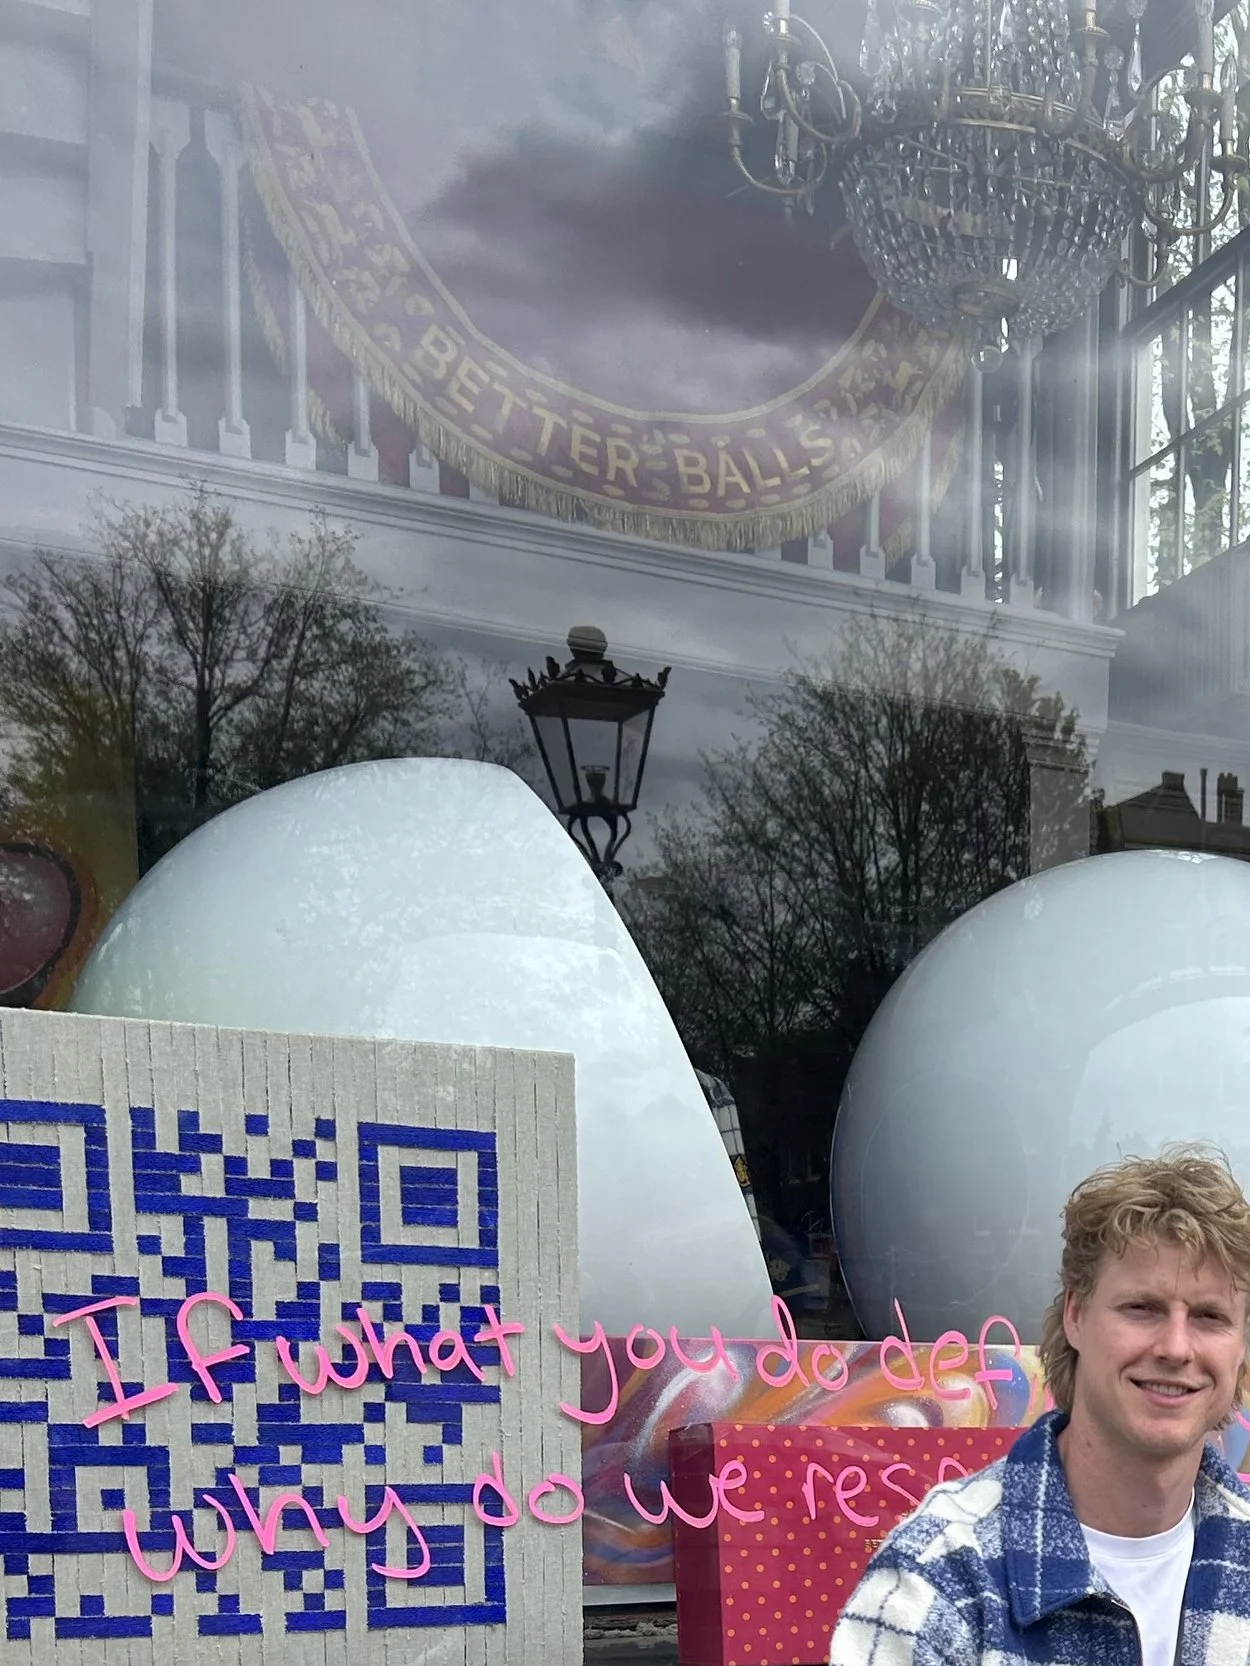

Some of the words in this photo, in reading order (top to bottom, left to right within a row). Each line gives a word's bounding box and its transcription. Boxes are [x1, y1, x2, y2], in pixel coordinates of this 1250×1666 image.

[420, 323, 640, 488] BETTER
[673, 426, 836, 497] BALLS
[276, 1304, 525, 1395] what
[554, 1321, 739, 1425] you
[756, 1295, 849, 1391] do
[472, 1451, 585, 1527] do
[623, 1459, 765, 1529] we
